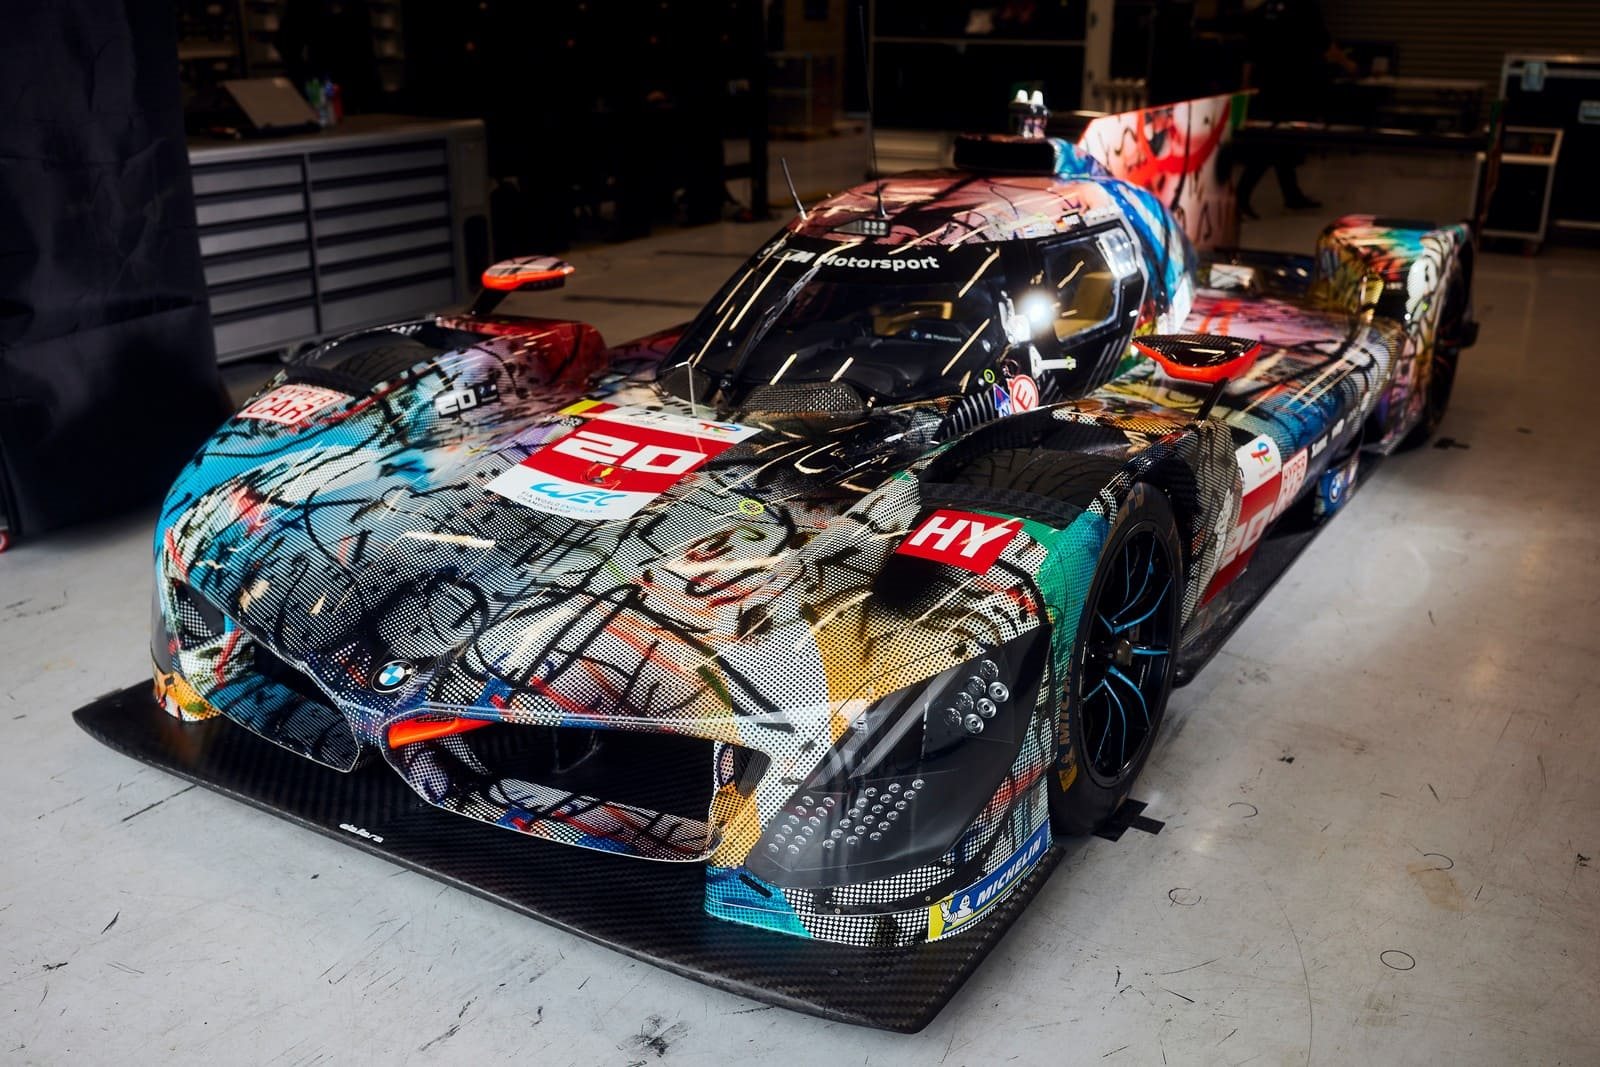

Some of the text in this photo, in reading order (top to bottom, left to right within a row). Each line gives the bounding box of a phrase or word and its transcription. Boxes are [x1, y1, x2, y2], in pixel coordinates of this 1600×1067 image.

[821, 254, 940, 271] Motorsport
[247, 398, 314, 420] CAR
[551, 431, 708, 475] 20
[908, 516, 1012, 558] HY
[976, 836, 1042, 907] MICHELIN
